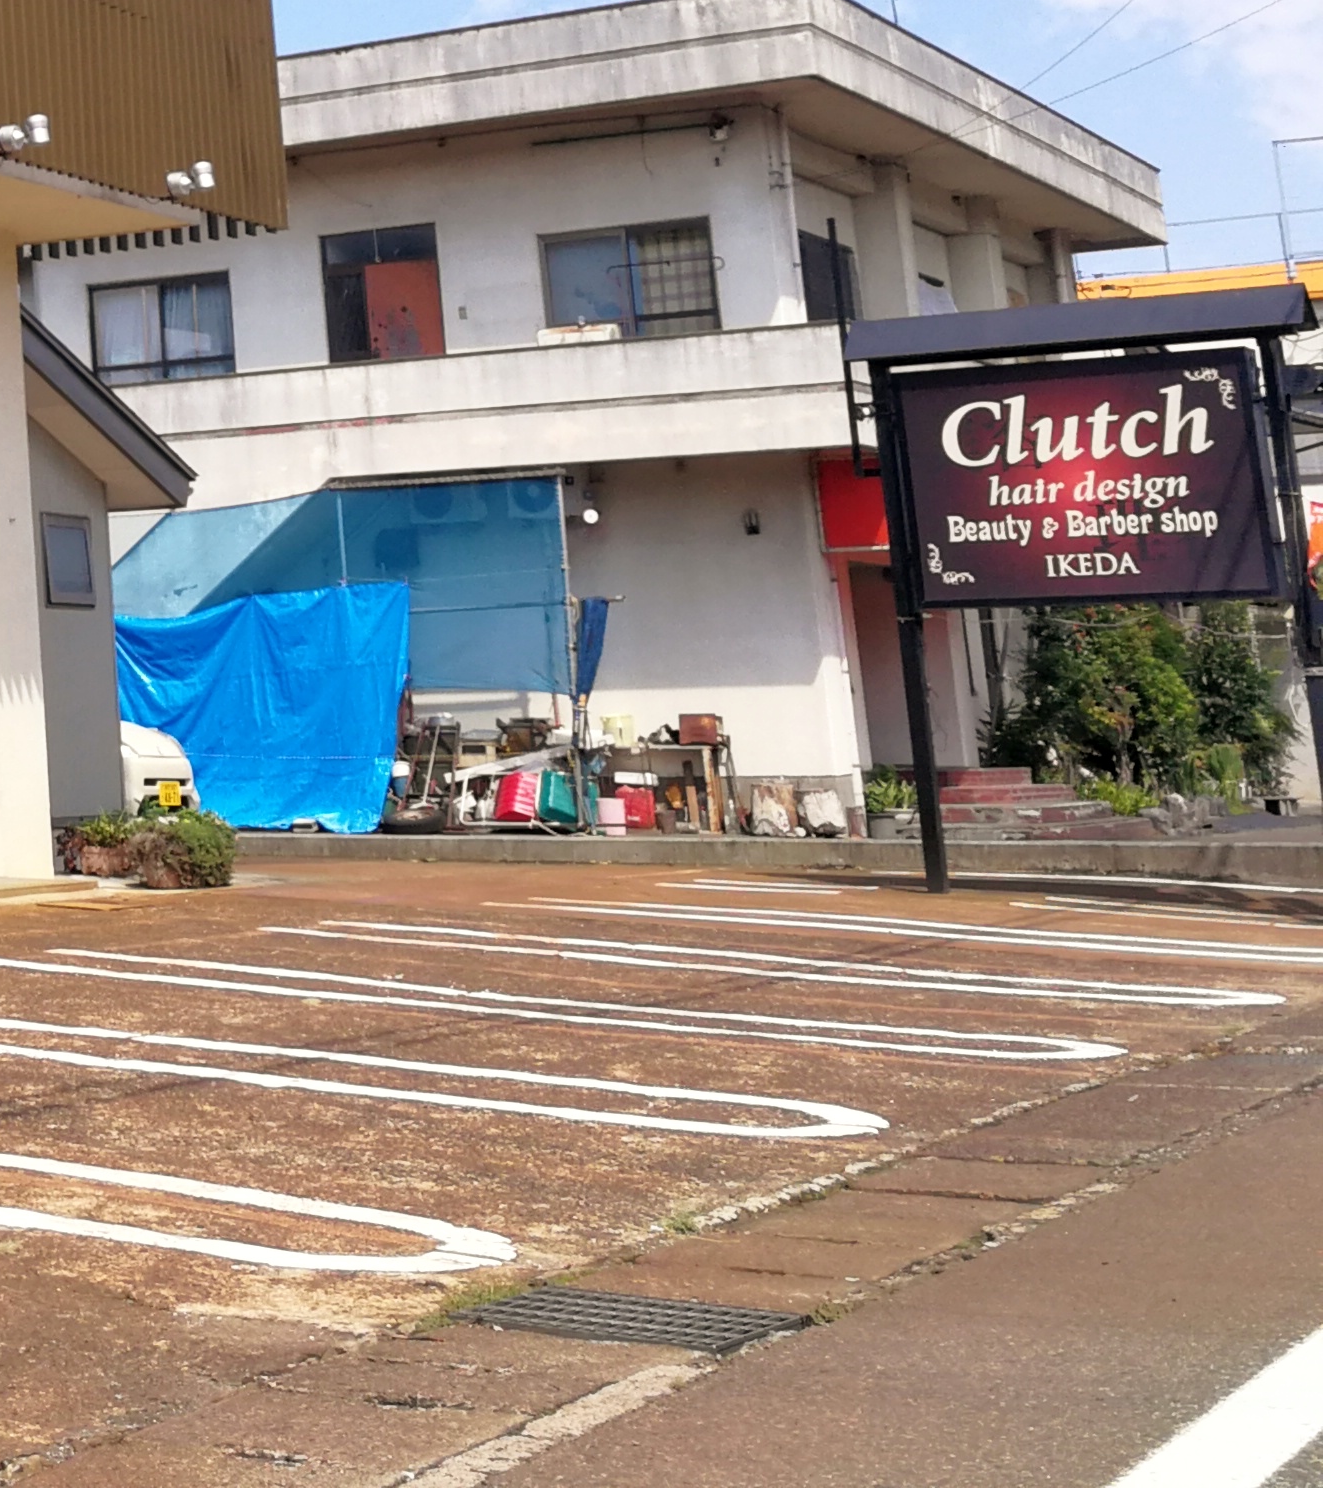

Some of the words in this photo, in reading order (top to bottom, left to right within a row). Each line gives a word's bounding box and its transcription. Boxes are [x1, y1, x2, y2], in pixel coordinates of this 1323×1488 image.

[941, 383, 1215, 468] Clutch
[988, 475, 1065, 507] hair
[1072, 469, 1191, 509] design
[946, 514, 1033, 548] Beauty
[1041, 516, 1060, 540] &
[1064, 508, 1154, 539] Barber
[1159, 505, 1219, 539] shop
[1044, 551, 1142, 578] IKEDA
